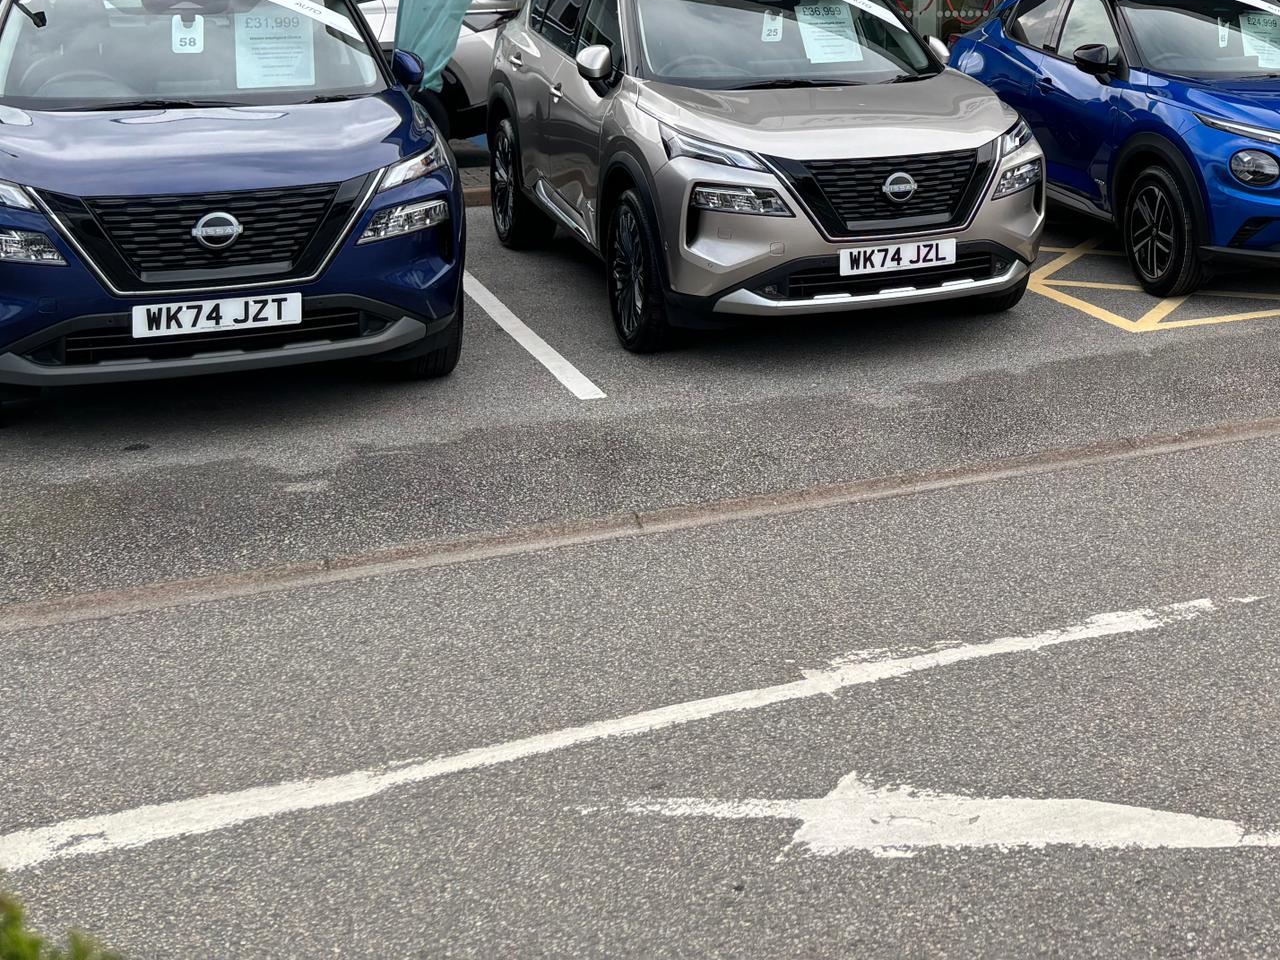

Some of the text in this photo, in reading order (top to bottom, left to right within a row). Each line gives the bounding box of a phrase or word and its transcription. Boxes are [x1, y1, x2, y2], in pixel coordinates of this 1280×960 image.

[293, 2, 323, 16] AUTO
[802, 6, 842, 16] £36,999
[244, 17, 300, 29] £31,999
[766, 28, 778, 37] 25
[179, 37, 197, 47] 58
[193, 224, 243, 236] NISSAN
[849, 243, 946, 271] WK74 JZL
[146, 297, 288, 331] WK74 JZT
